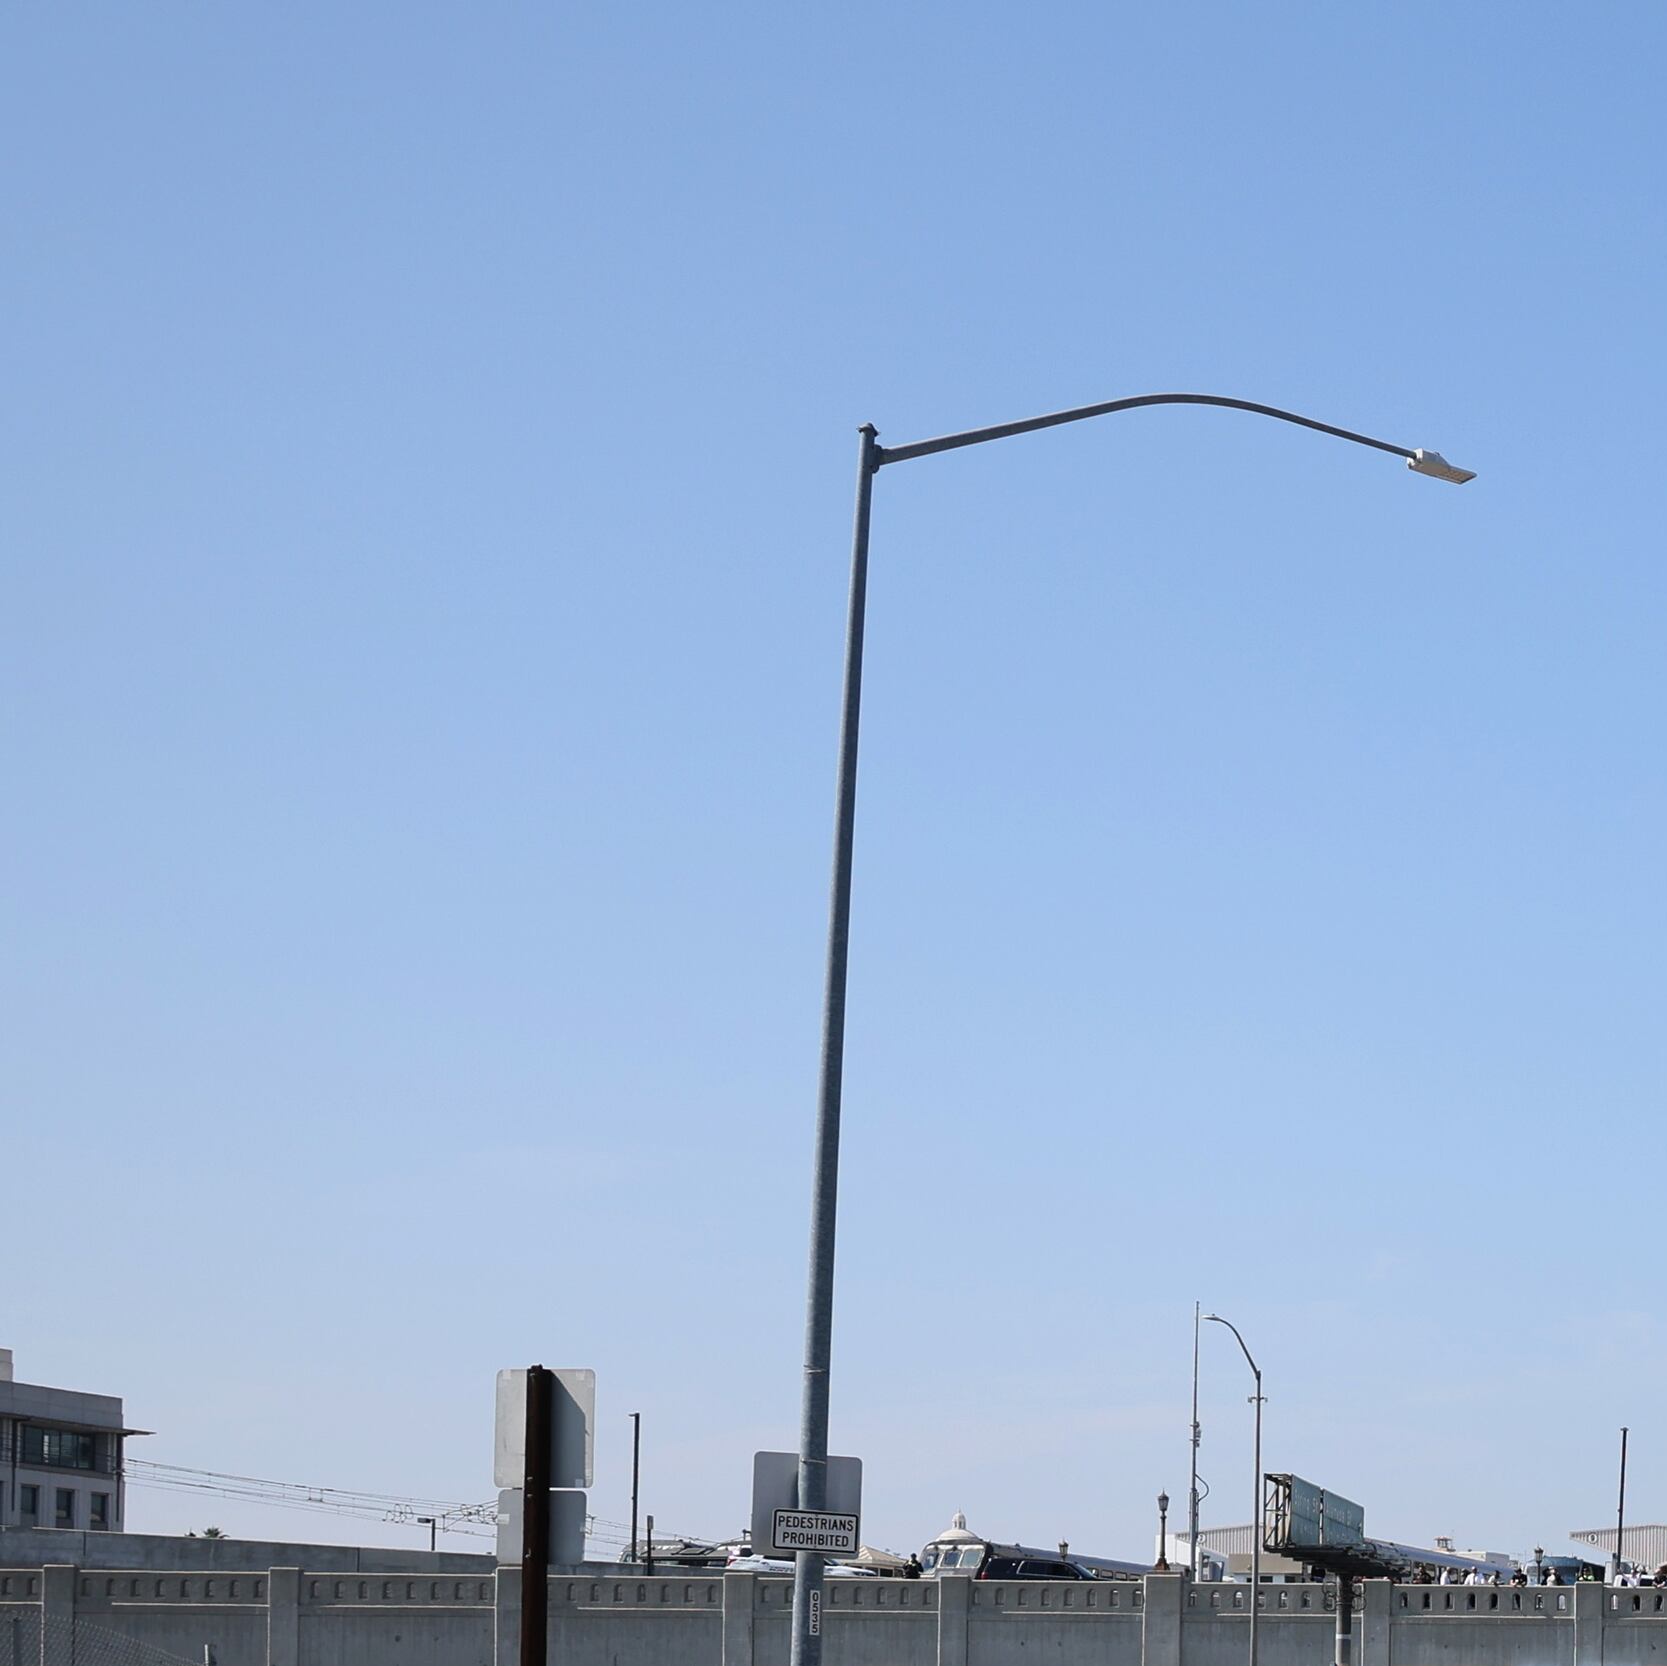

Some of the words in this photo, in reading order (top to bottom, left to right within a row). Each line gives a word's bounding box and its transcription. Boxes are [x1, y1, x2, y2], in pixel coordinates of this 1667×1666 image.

[778, 1515, 854, 1532] PEDESTRIANS
[782, 1532, 849, 1547] PROHIBITED
[811, 1592, 819, 1634] 0535
